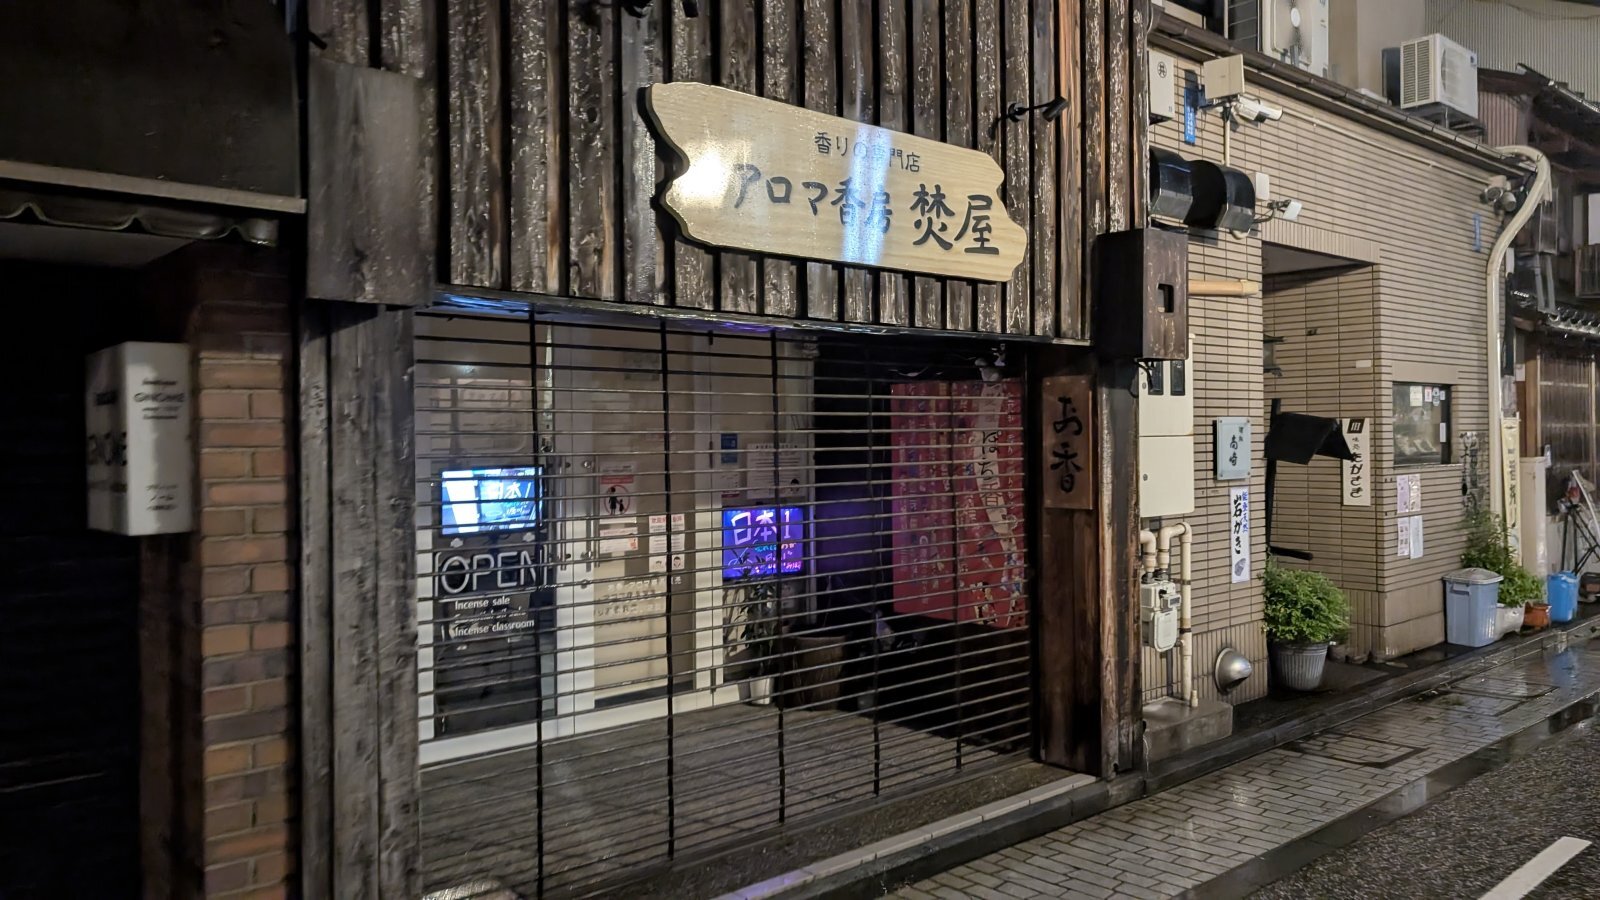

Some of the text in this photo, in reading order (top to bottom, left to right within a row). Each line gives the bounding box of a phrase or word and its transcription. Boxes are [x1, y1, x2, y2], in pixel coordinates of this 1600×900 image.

[814, 131, 921, 173] 香りの専門店
[909, 183, 1000, 256] 焚屋
[1050, 396, 1083, 493] お香
[441, 550, 538, 594] OPEN
[455, 595, 511, 610] Incense sale
[455, 619, 535, 636] Incense classroom
